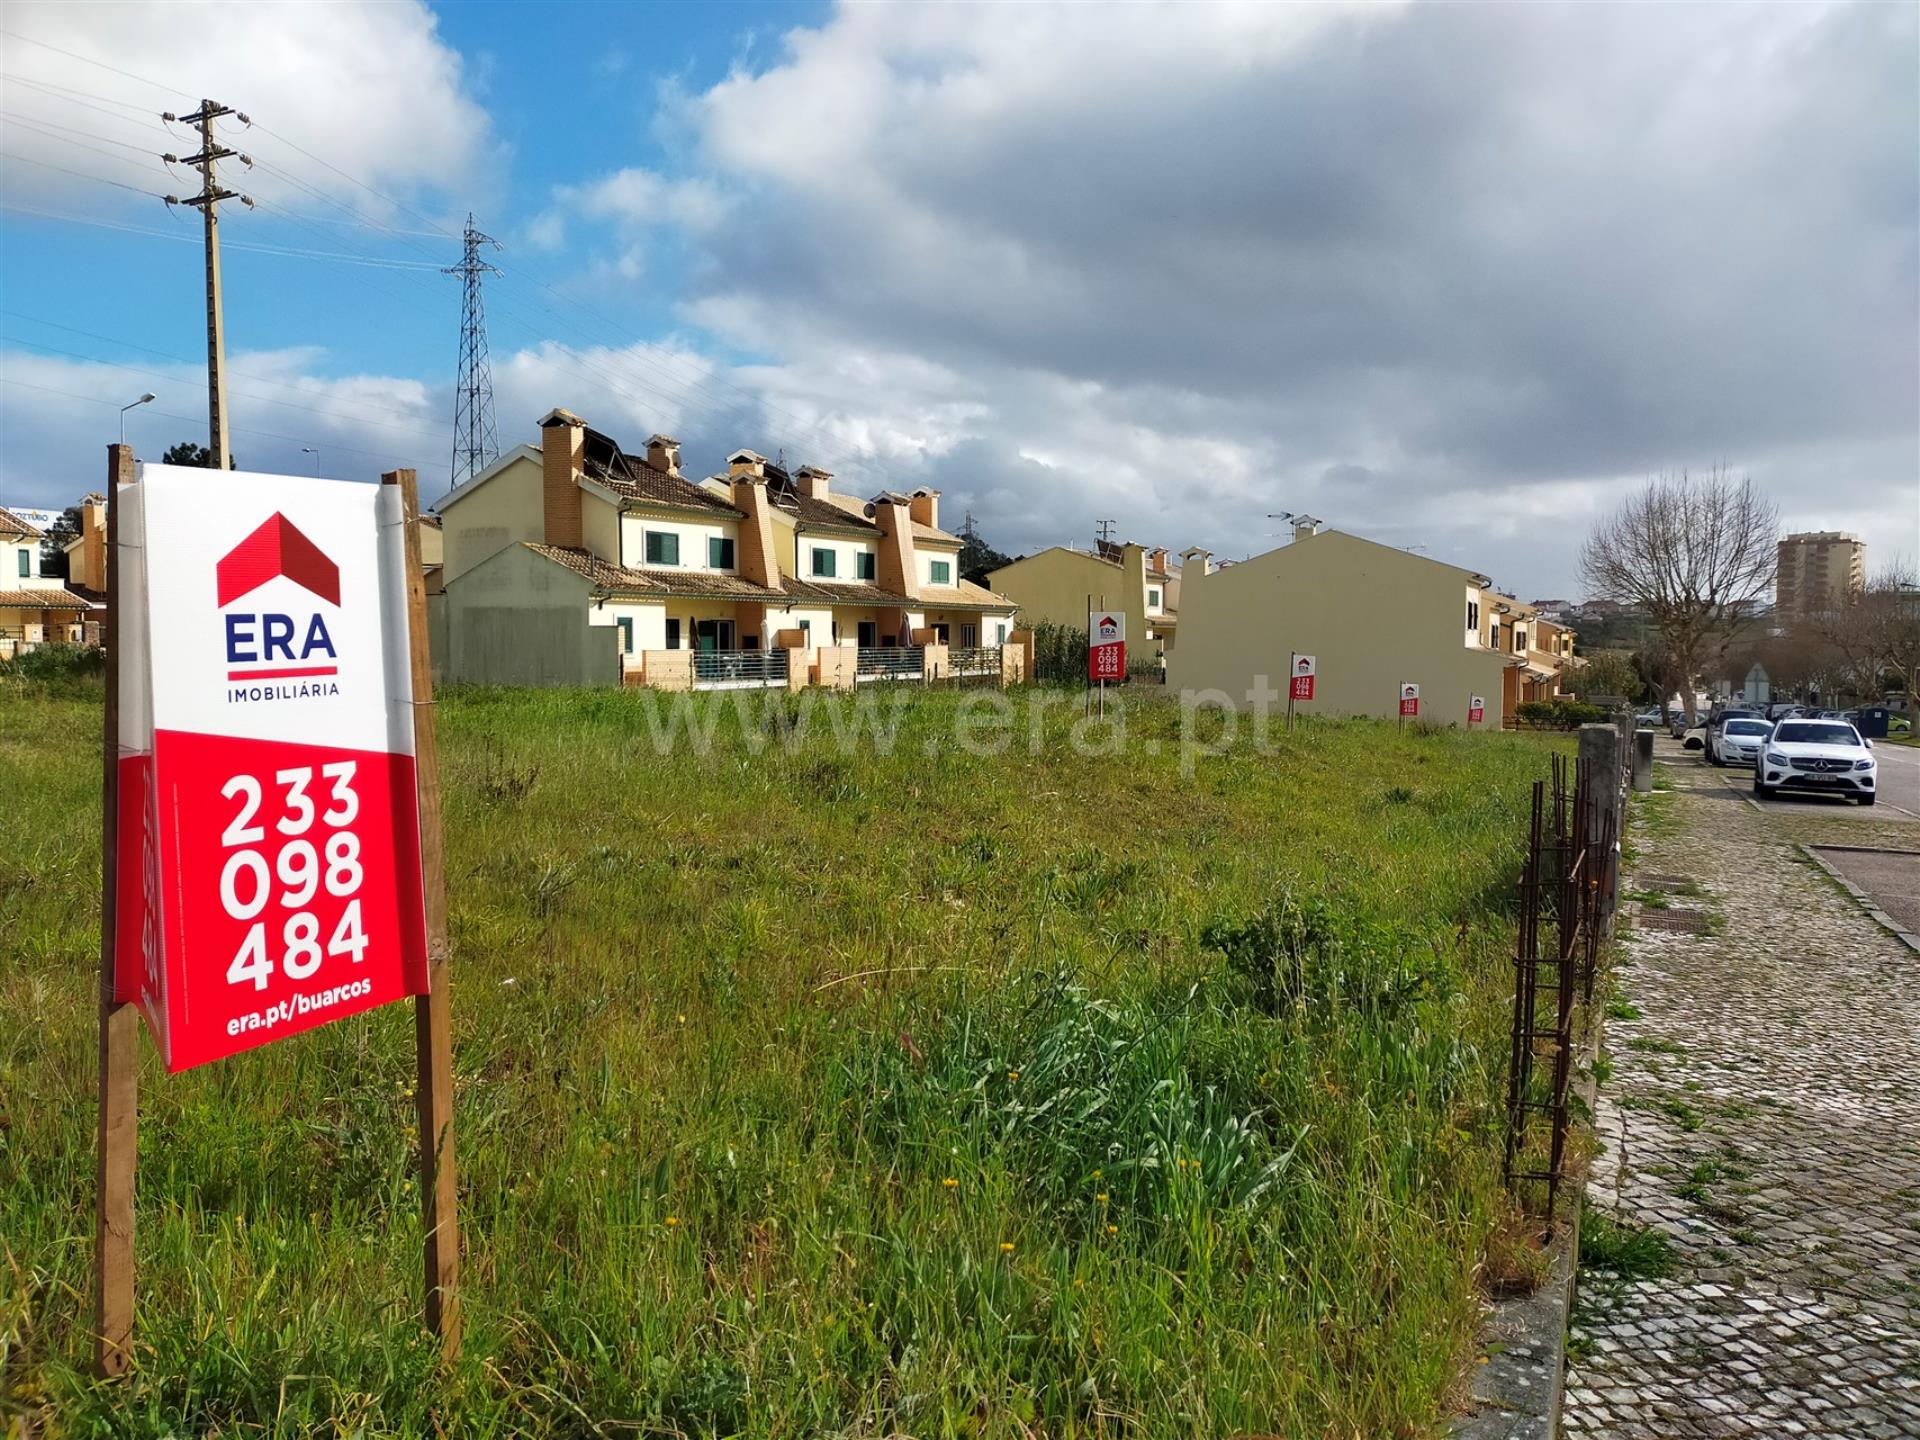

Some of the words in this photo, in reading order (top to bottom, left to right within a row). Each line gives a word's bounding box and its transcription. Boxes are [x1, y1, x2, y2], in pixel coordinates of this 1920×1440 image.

[226, 613, 337, 663] ERA
[1098, 646, 1118, 656] 233
[1098, 655, 1118, 664] 098
[228, 681, 339, 703] IMOBILIÁRIA
[1098, 664, 1118, 673] 484
[220, 760, 359, 848] 233
[219, 830, 364, 921] 098
[226, 898, 369, 992] 484
[226, 977, 372, 1037] era.pt/buarcos
